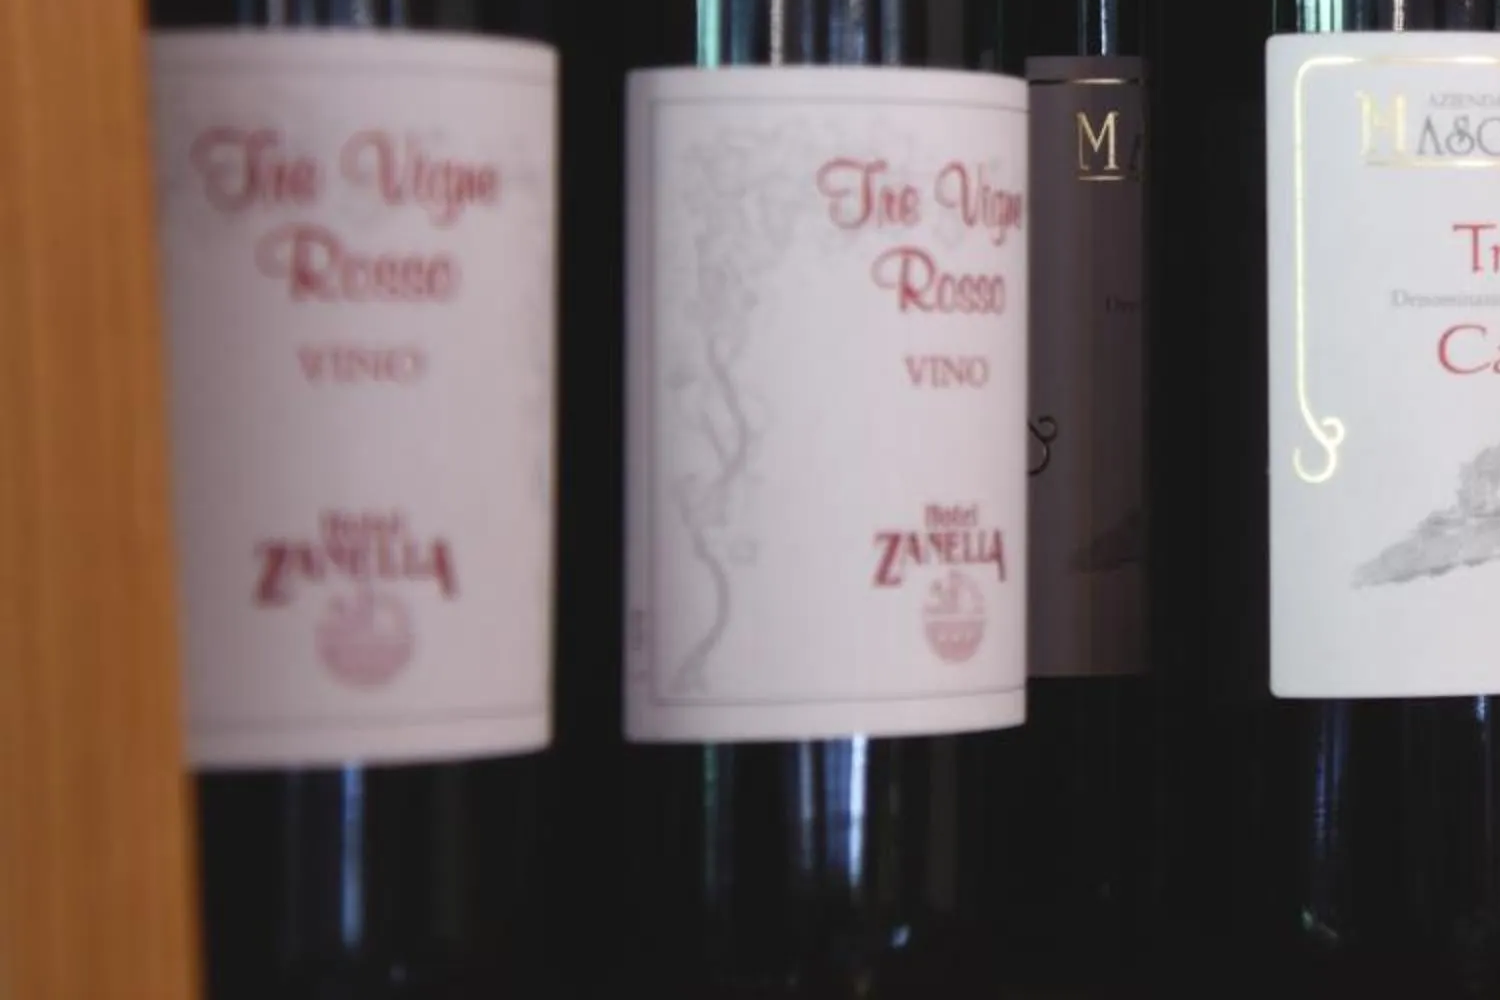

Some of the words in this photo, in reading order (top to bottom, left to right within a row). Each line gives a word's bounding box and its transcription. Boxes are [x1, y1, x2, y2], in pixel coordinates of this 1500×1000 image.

[816, 157, 922, 231] Tre
[871, 246, 1006, 315] Rosso
[905, 354, 991, 387] VINO
